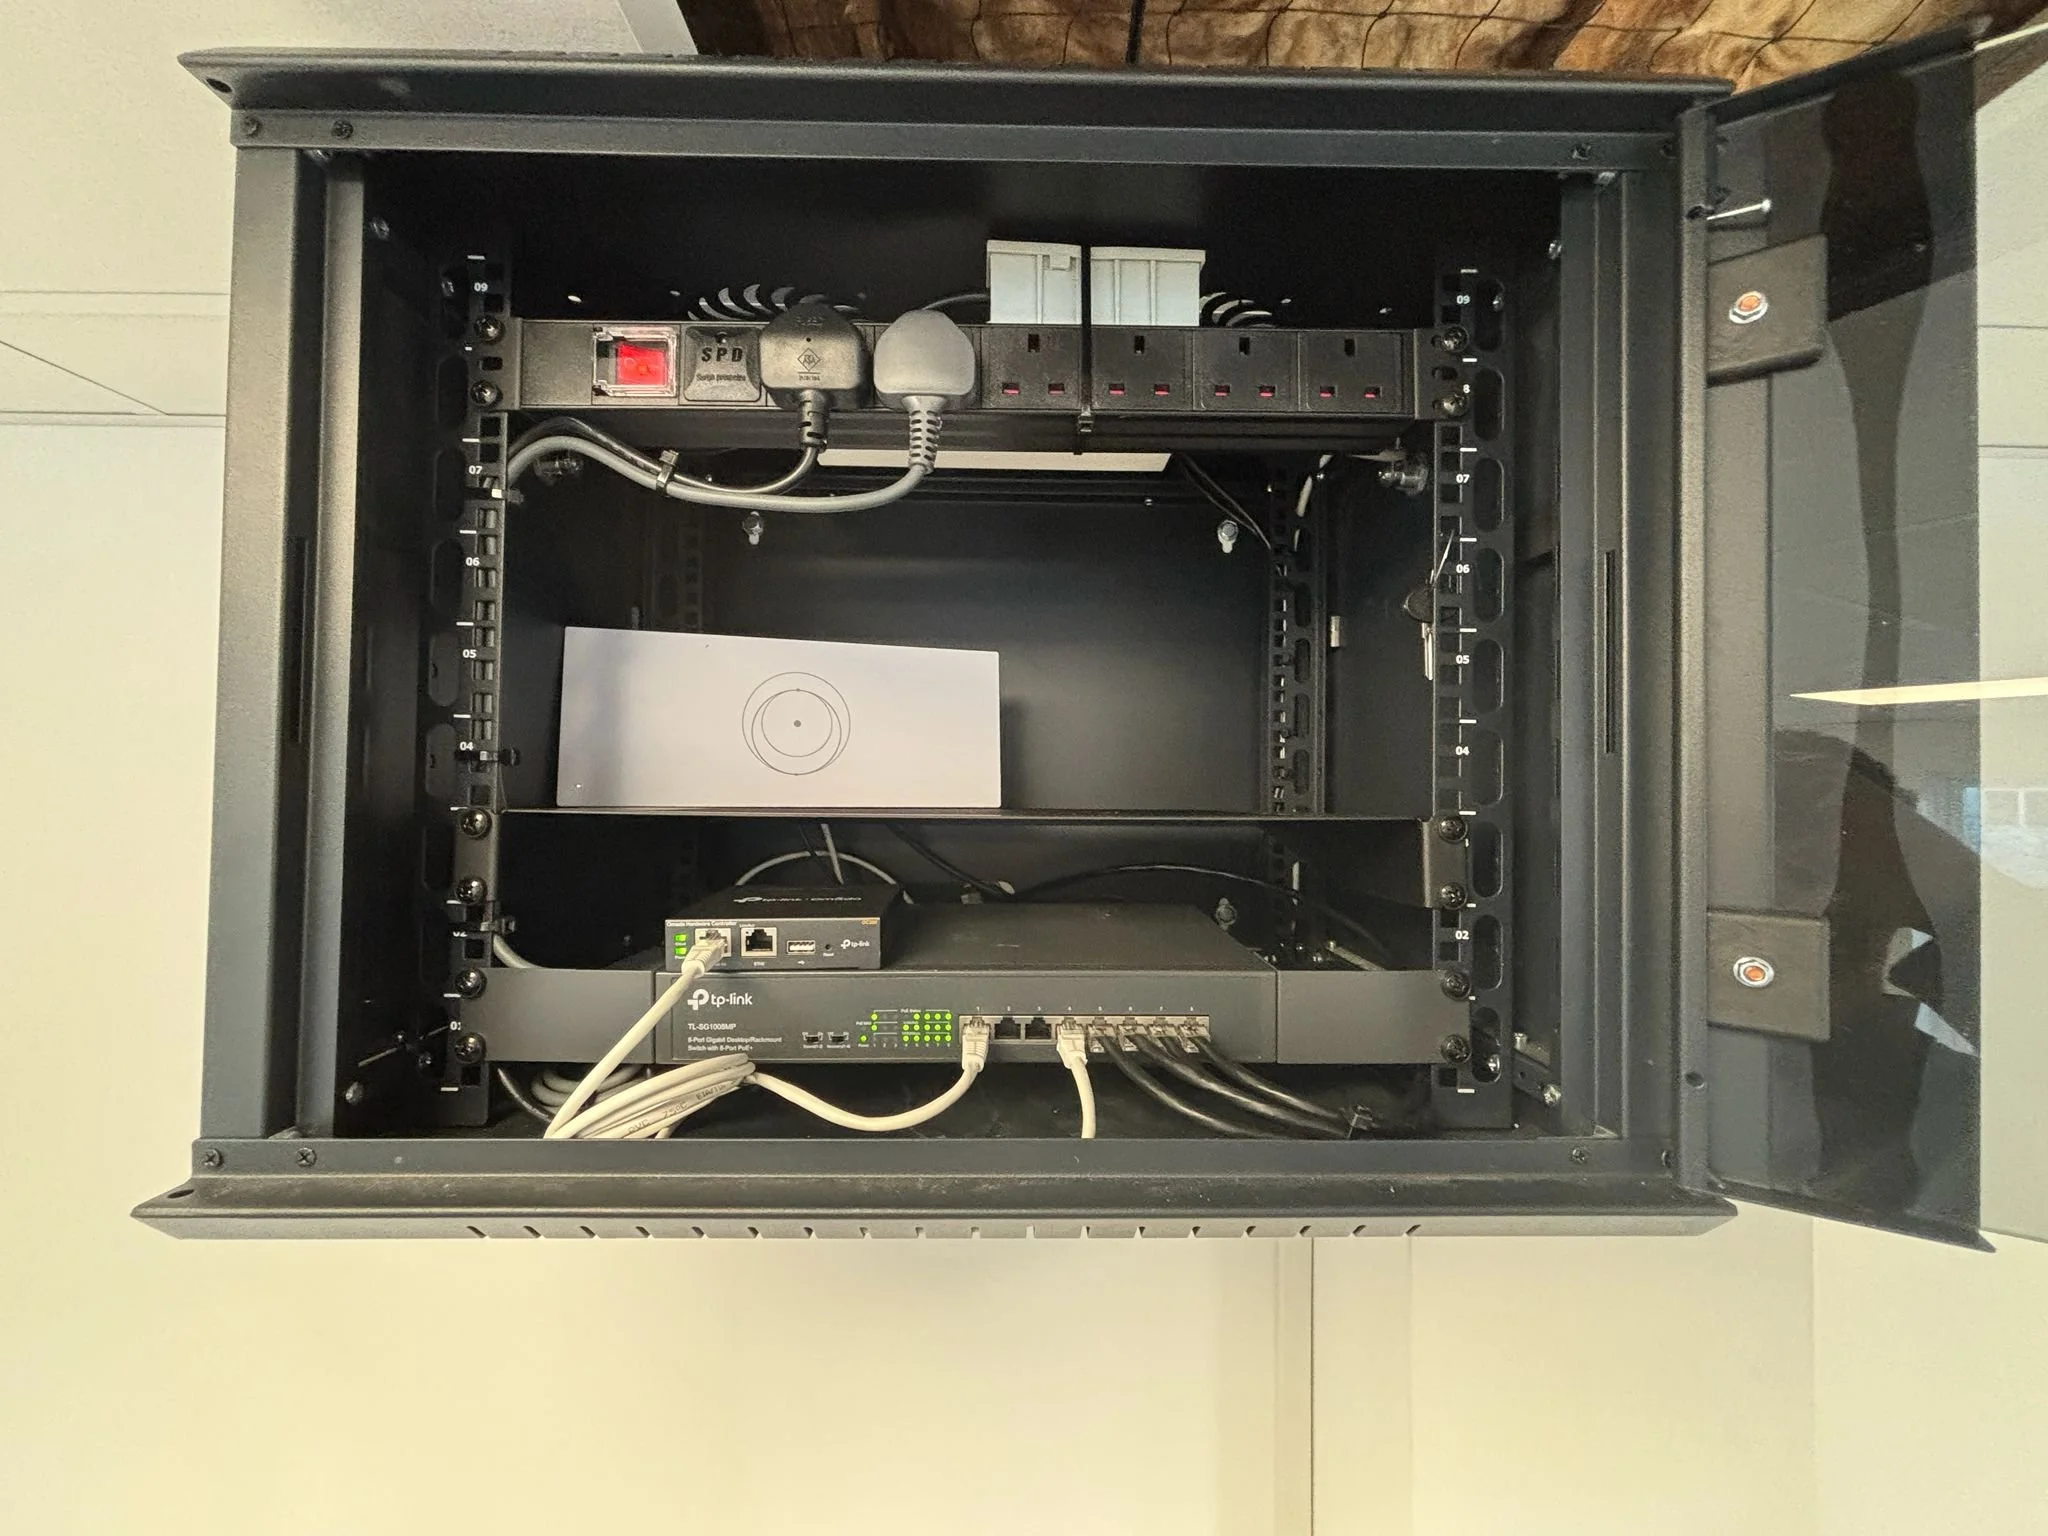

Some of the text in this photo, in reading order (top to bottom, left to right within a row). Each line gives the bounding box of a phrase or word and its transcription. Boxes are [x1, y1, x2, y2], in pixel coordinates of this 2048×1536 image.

[473, 282, 488, 292] 09
[1456, 295, 1470, 304] 09
[468, 465, 483, 475] 07
[1456, 474, 1470, 483] 07
[465, 557, 480, 567] 06
[1456, 564, 1470, 574] 06
[462, 649, 477, 659] 05
[1455, 655, 1470, 664] 05
[459, 741, 474, 751] 04
[1455, 746, 1470, 755] 04
[1455, 930, 1470, 940] 02
[711, 992, 753, 1008] tp-link
